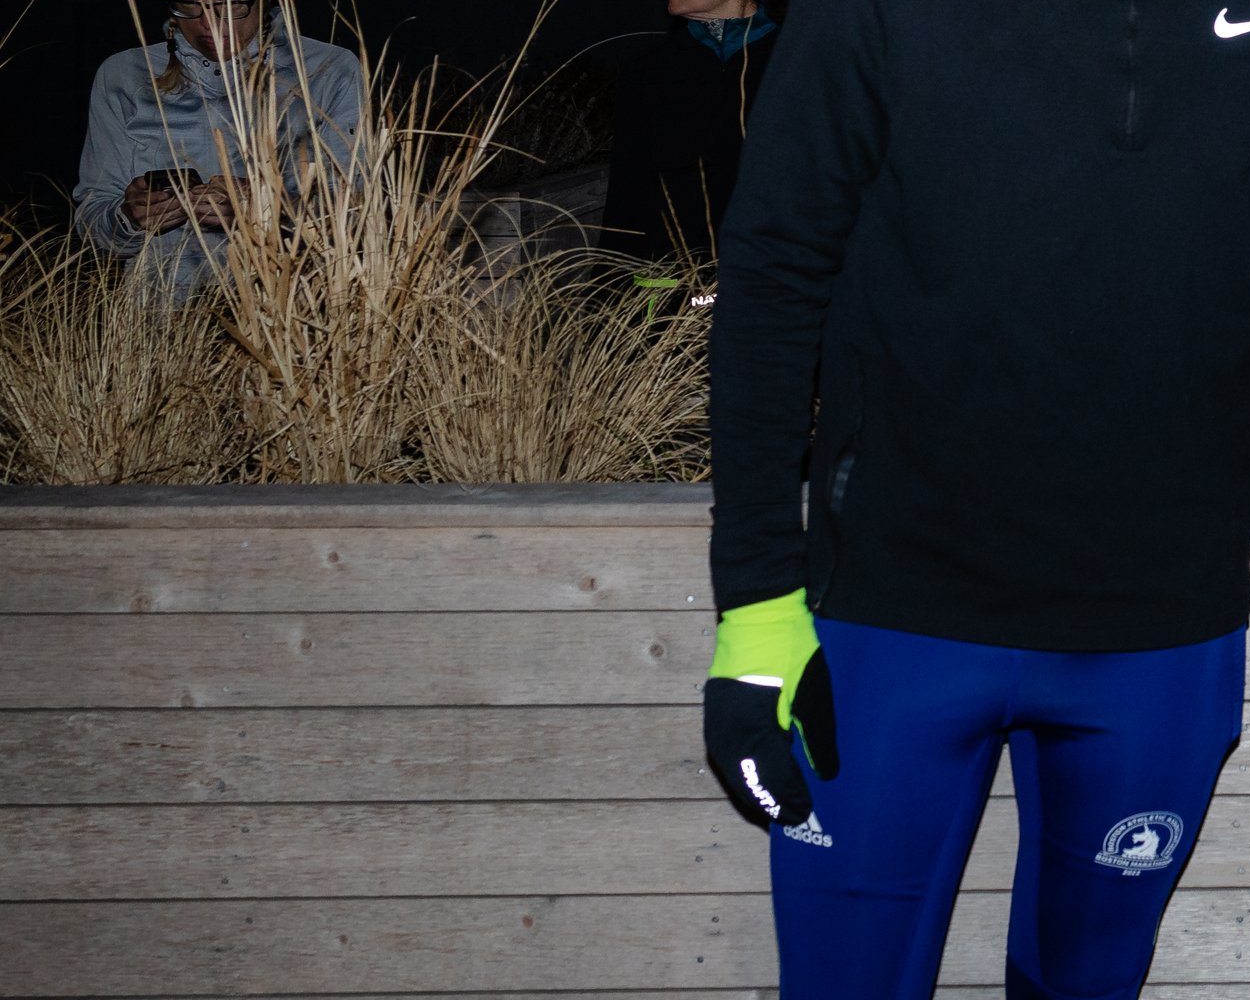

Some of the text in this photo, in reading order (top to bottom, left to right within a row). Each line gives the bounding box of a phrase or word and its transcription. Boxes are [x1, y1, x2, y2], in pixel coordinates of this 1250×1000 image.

[691, 293, 718, 307] NA
[740, 757, 776, 807] CRAFT
[783, 824, 833, 848] adidas
[1095, 853, 1171, 868] BOSTON MARATHON
